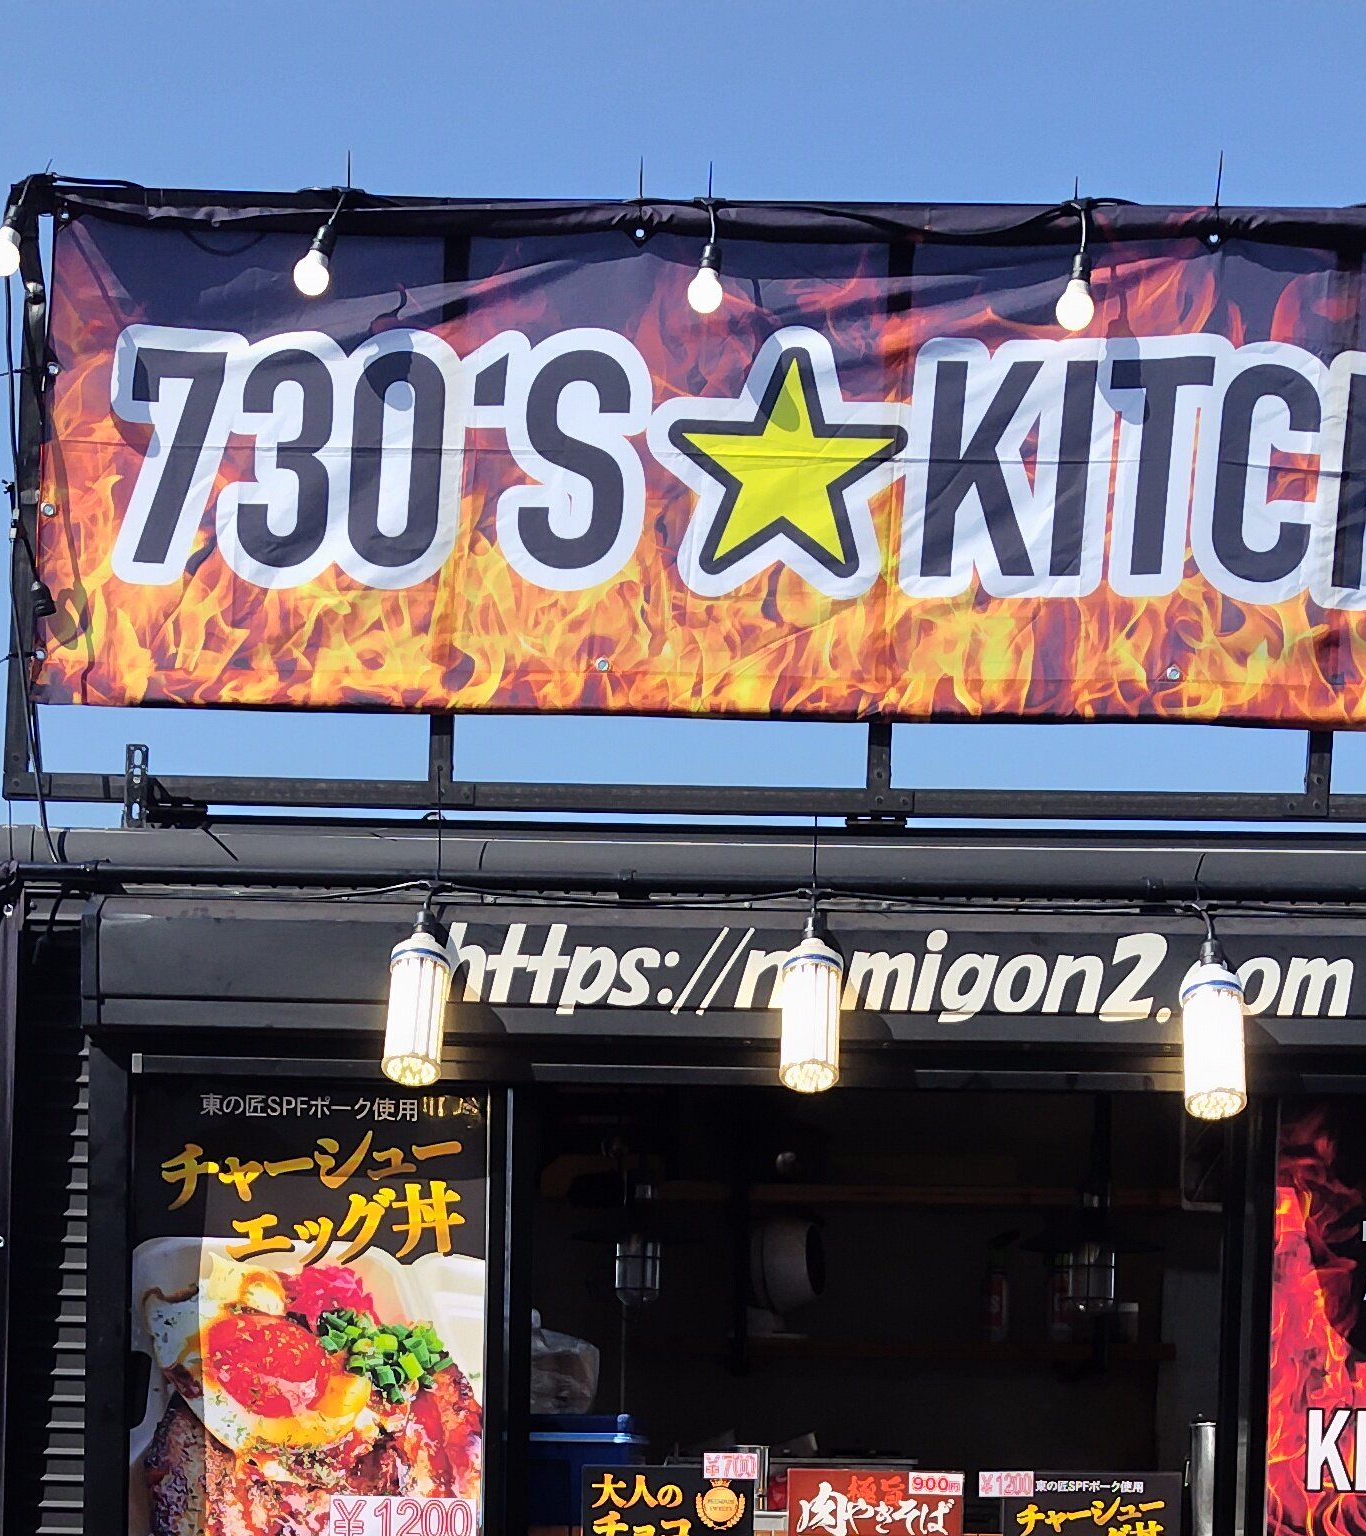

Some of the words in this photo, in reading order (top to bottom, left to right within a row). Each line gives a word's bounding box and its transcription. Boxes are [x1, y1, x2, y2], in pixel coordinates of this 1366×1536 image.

[125, 344, 638, 574] 730'S
[445, 922, 1354, 1024] https://nmigon2.om
[200, 1093, 418, 1121] 東の匠SPFポーク使用
[161, 1130, 462, 1210] チャーシュー
[225, 1181, 465, 1264] エッグ丼
[591, 1473, 683, 1508] 大人の
[847, 1475, 906, 1506] 極旨
[912, 1475, 961, 1492] 900円
[1035, 1480, 1144, 1493] 東の匠SPFポーク使用
